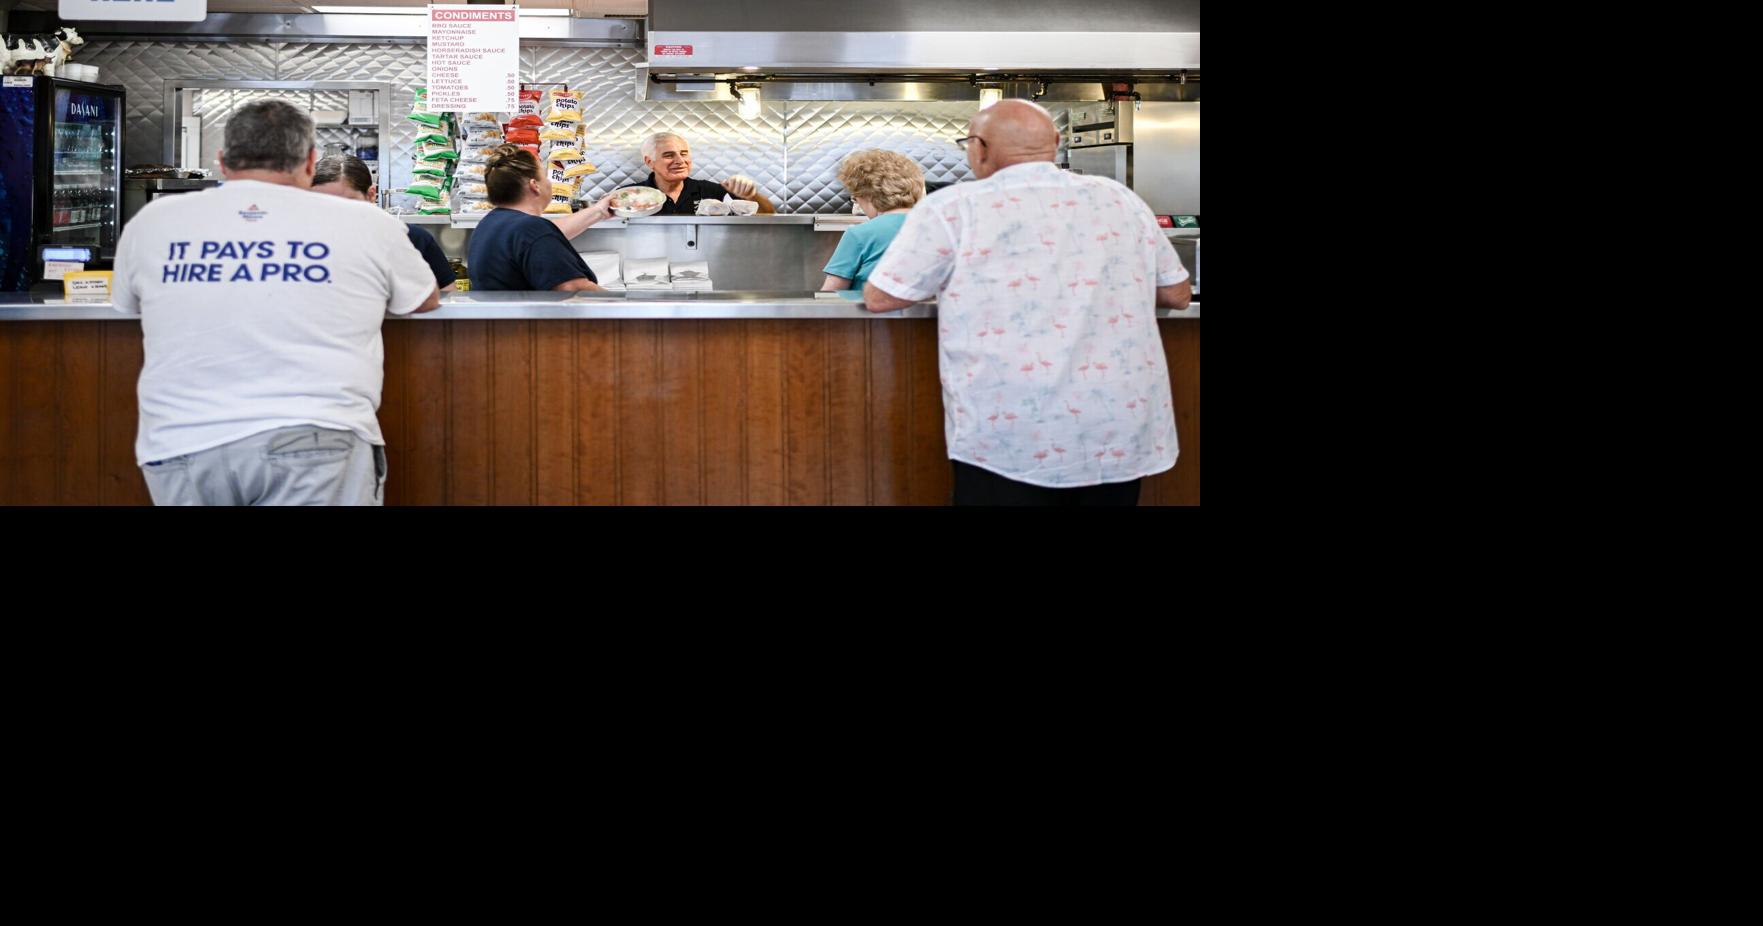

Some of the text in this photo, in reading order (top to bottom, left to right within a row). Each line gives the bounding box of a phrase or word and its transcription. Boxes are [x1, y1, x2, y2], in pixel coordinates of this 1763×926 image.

[434, 12, 512, 20] CONDIMENTS
[71, 101, 98, 118] DASANI
[168, 240, 330, 261] IT PAYS TO
[162, 263, 332, 284] HIRE A PRO.
